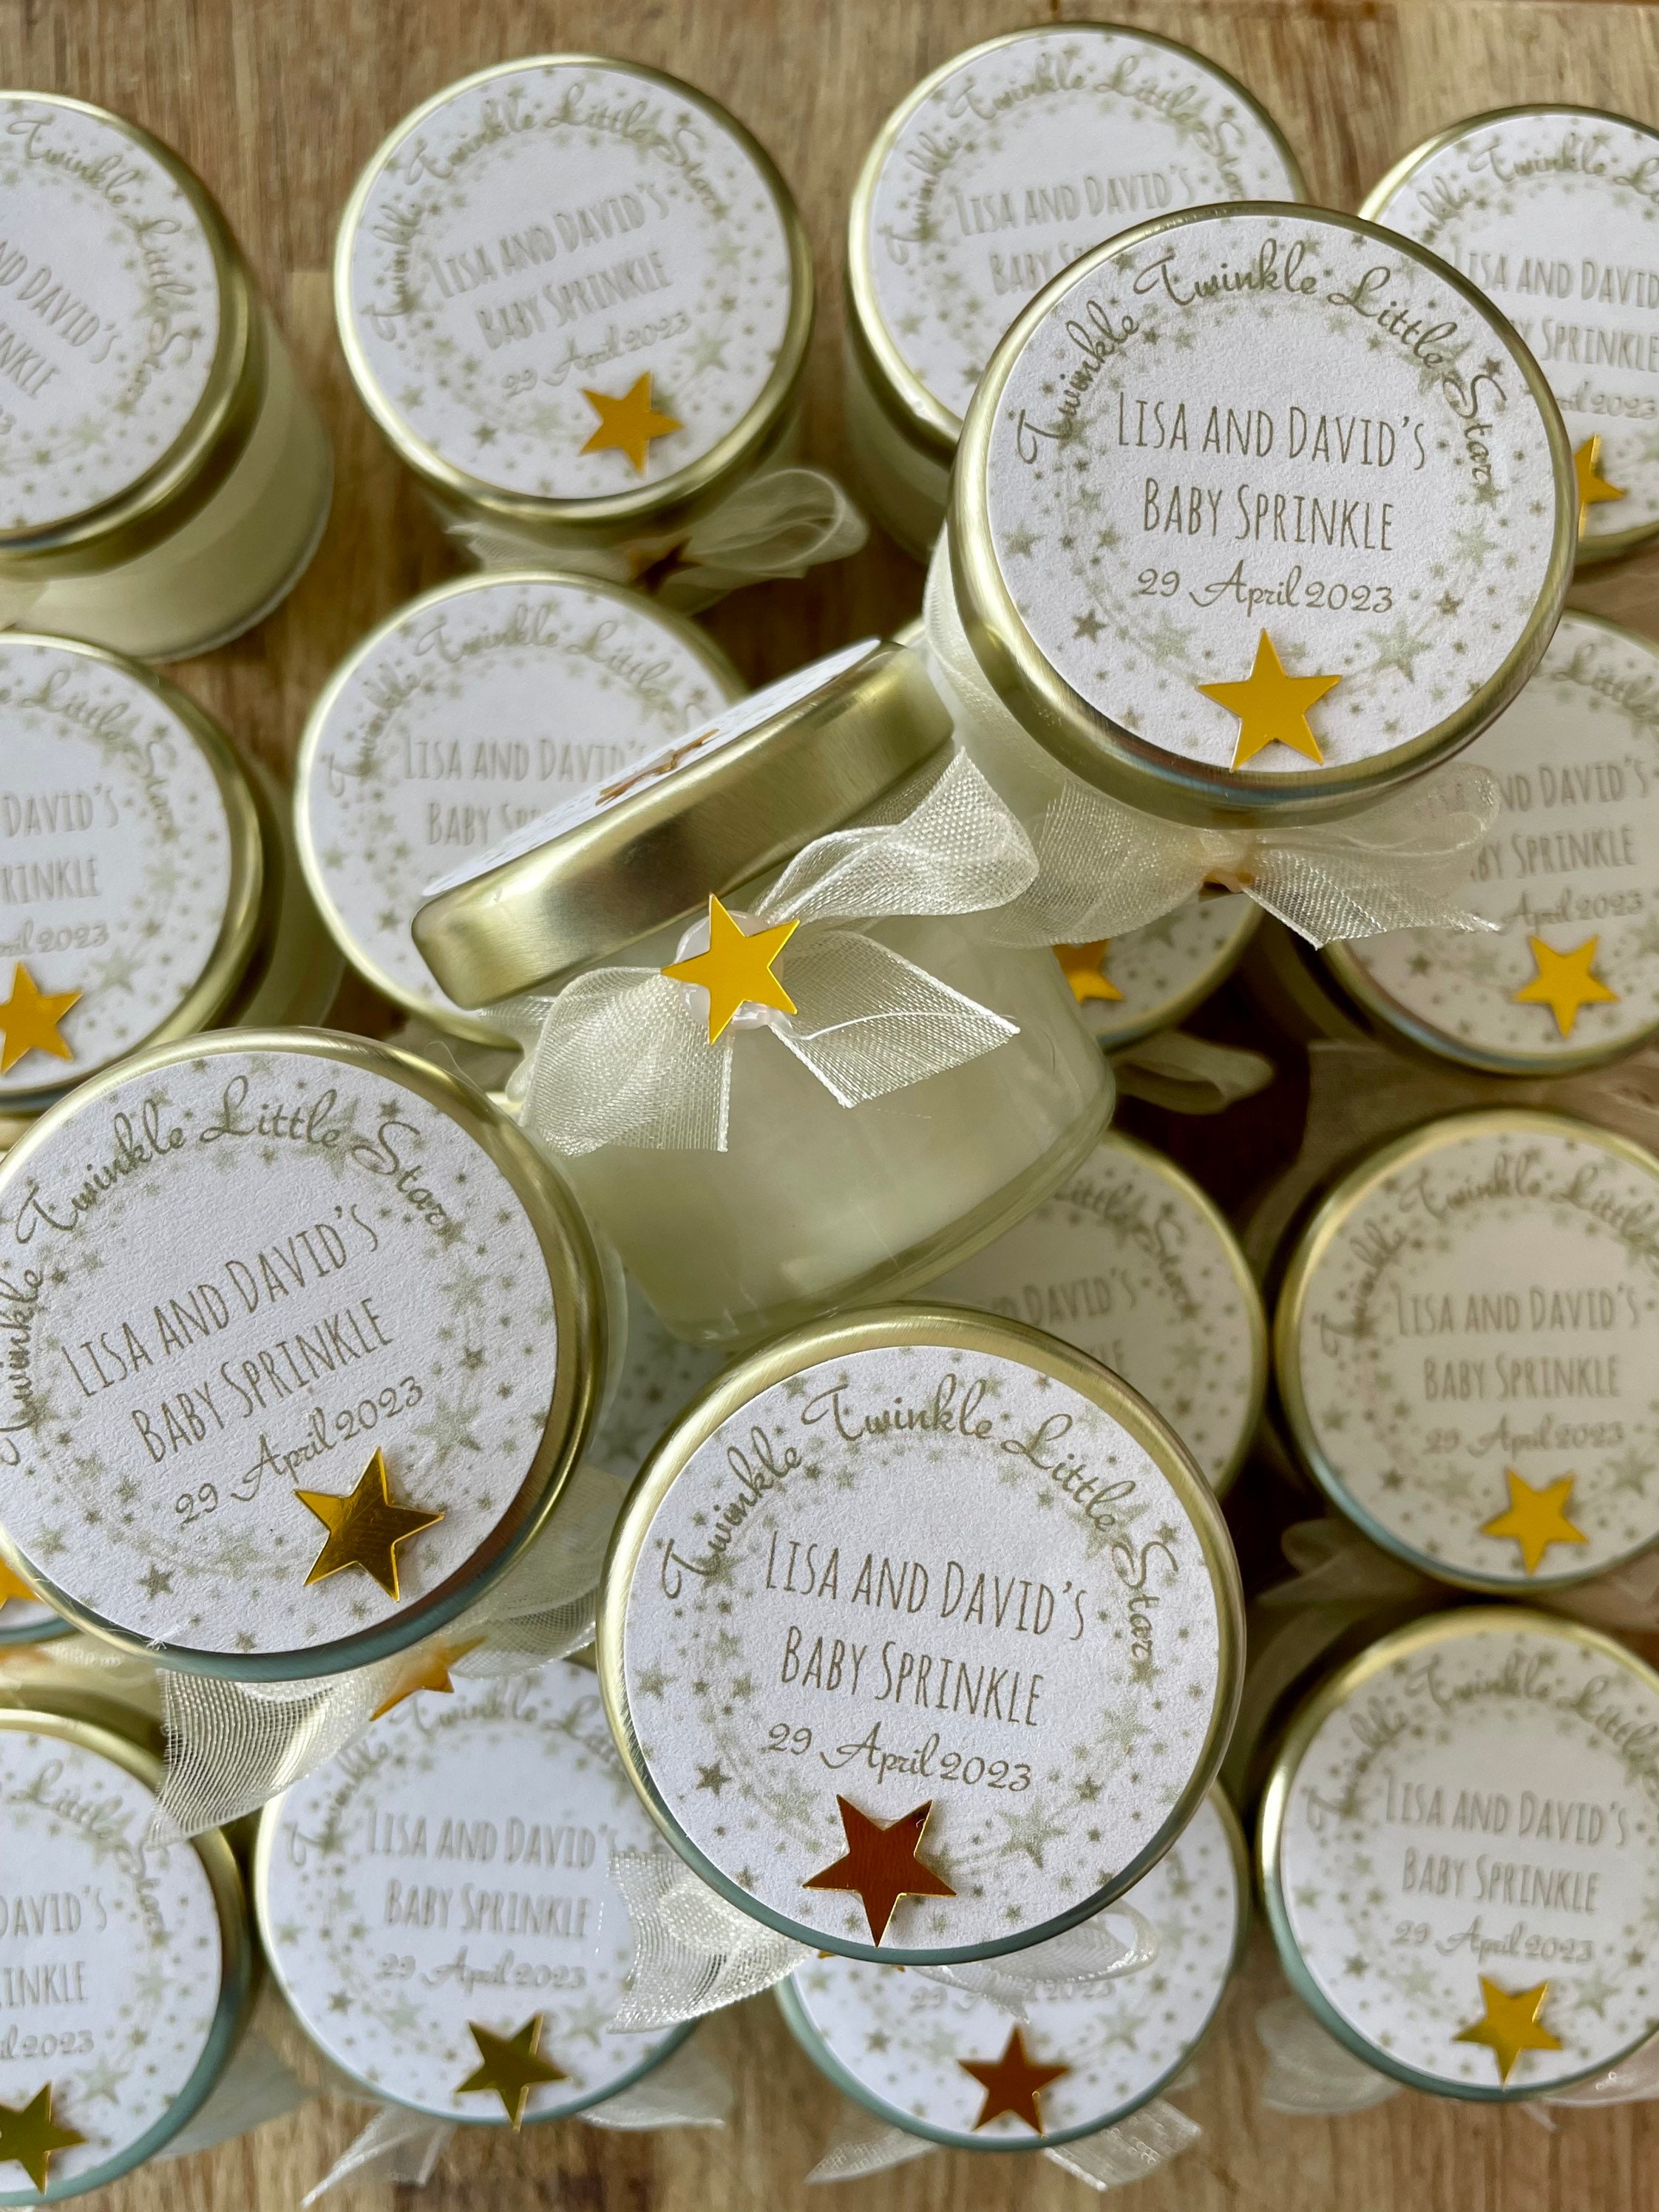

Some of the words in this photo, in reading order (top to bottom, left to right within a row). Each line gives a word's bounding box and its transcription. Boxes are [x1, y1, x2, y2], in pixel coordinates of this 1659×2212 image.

[959, 189, 1015, 237] LISA
[1023, 184, 1082, 223] AND
[1085, 163, 1198, 217] DAVID'S
[427, 245, 498, 298] LISA
[499, 225, 557, 276] AND
[553, 182, 670, 253] DAVID'S
[16, 265, 121, 364] DAVID'S
[475, 295, 546, 350] BABY
[542, 250, 674, 328] SPRINKLE
[1516, 258, 1574, 299] AND
[1016, 300, 1140, 466] Twinkle
[1134, 237, 1318, 307] Twinkle
[1328, 267, 1458, 369] Little
[1443, 373, 1507, 486] Star
[1116, 391, 1186, 449] LISA
[1203, 406, 1272, 458] AND
[1289, 406, 1426, 470] DAVID'S
[1143, 477, 1223, 537] BABY
[1236, 483, 1394, 552] SPRINKLE
[1137, 568, 1181, 599] 29
[1189, 559, 1306, 617] April
[1305, 583, 1396, 614] 2023
[415, 603, 560, 662] Twinkle
[566, 620, 672, 696] Little
[405, 738, 462, 780] LISA
[474, 740, 529, 781] AND
[1538, 755, 1649, 809] DAVID'S
[2, 781, 119, 838] DAVID'S
[428, 803, 491, 845] BABY
[1511, 826, 1636, 878] SPRINKLE
[36, 923, 109, 952] 2023
[16, 1098, 185, 1244] Twinkle
[199, 1075, 341, 1150] Little
[351, 1122, 447, 1224] Star
[60, 1320, 152, 1399] LISA
[155, 1283, 229, 1354] AND
[225, 1202, 379, 1314] DAVID'S
[1397, 1290, 1453, 1335] LISA
[1465, 1293, 1519, 1334] AND
[1530, 1284, 1639, 1331] DAVID'S
[131, 1379, 226, 1465] BABY
[223, 1296, 393, 1419] SPRINKLE
[1423, 1356, 1485, 1400] BABY
[1496, 1353, 1623, 1400] SPRINKLE
[174, 1482, 218, 1527] 29
[230, 1406, 333, 1501] April
[333, 1374, 424, 1444] 2023
[660, 1426, 802, 1600] Twinkle
[801, 1373, 991, 1442] Twinkle
[1001, 1413, 1136, 1534] Little
[1111, 1540, 1178, 1660] Star
[765, 1530, 838, 1593] LISA
[851, 1552, 927, 1614] AND
[940, 1560, 1085, 1642] DAVID'S
[782, 1624, 867, 1694] BABY
[875, 1640, 1044, 1728] SPRINKLE
[767, 1721, 812, 1754] 29
[820, 1720, 941, 1785] April
[940, 1753, 1032, 1793] 2023
[367, 1808, 427, 1855] LISA
[436, 1817, 497, 1861] AND
[1385, 1776, 1443, 1828] LISA
[1451, 1786, 1510, 1833] AND
[1519, 1790, 1626, 1845] DAVID'S
[384, 1878, 452, 1929] BABY
[461, 1882, 590, 1938] SPRINKLE
[1401, 1847, 1467, 1897] BABY
[1475, 1852, 1600, 1913] SPRINKLE
